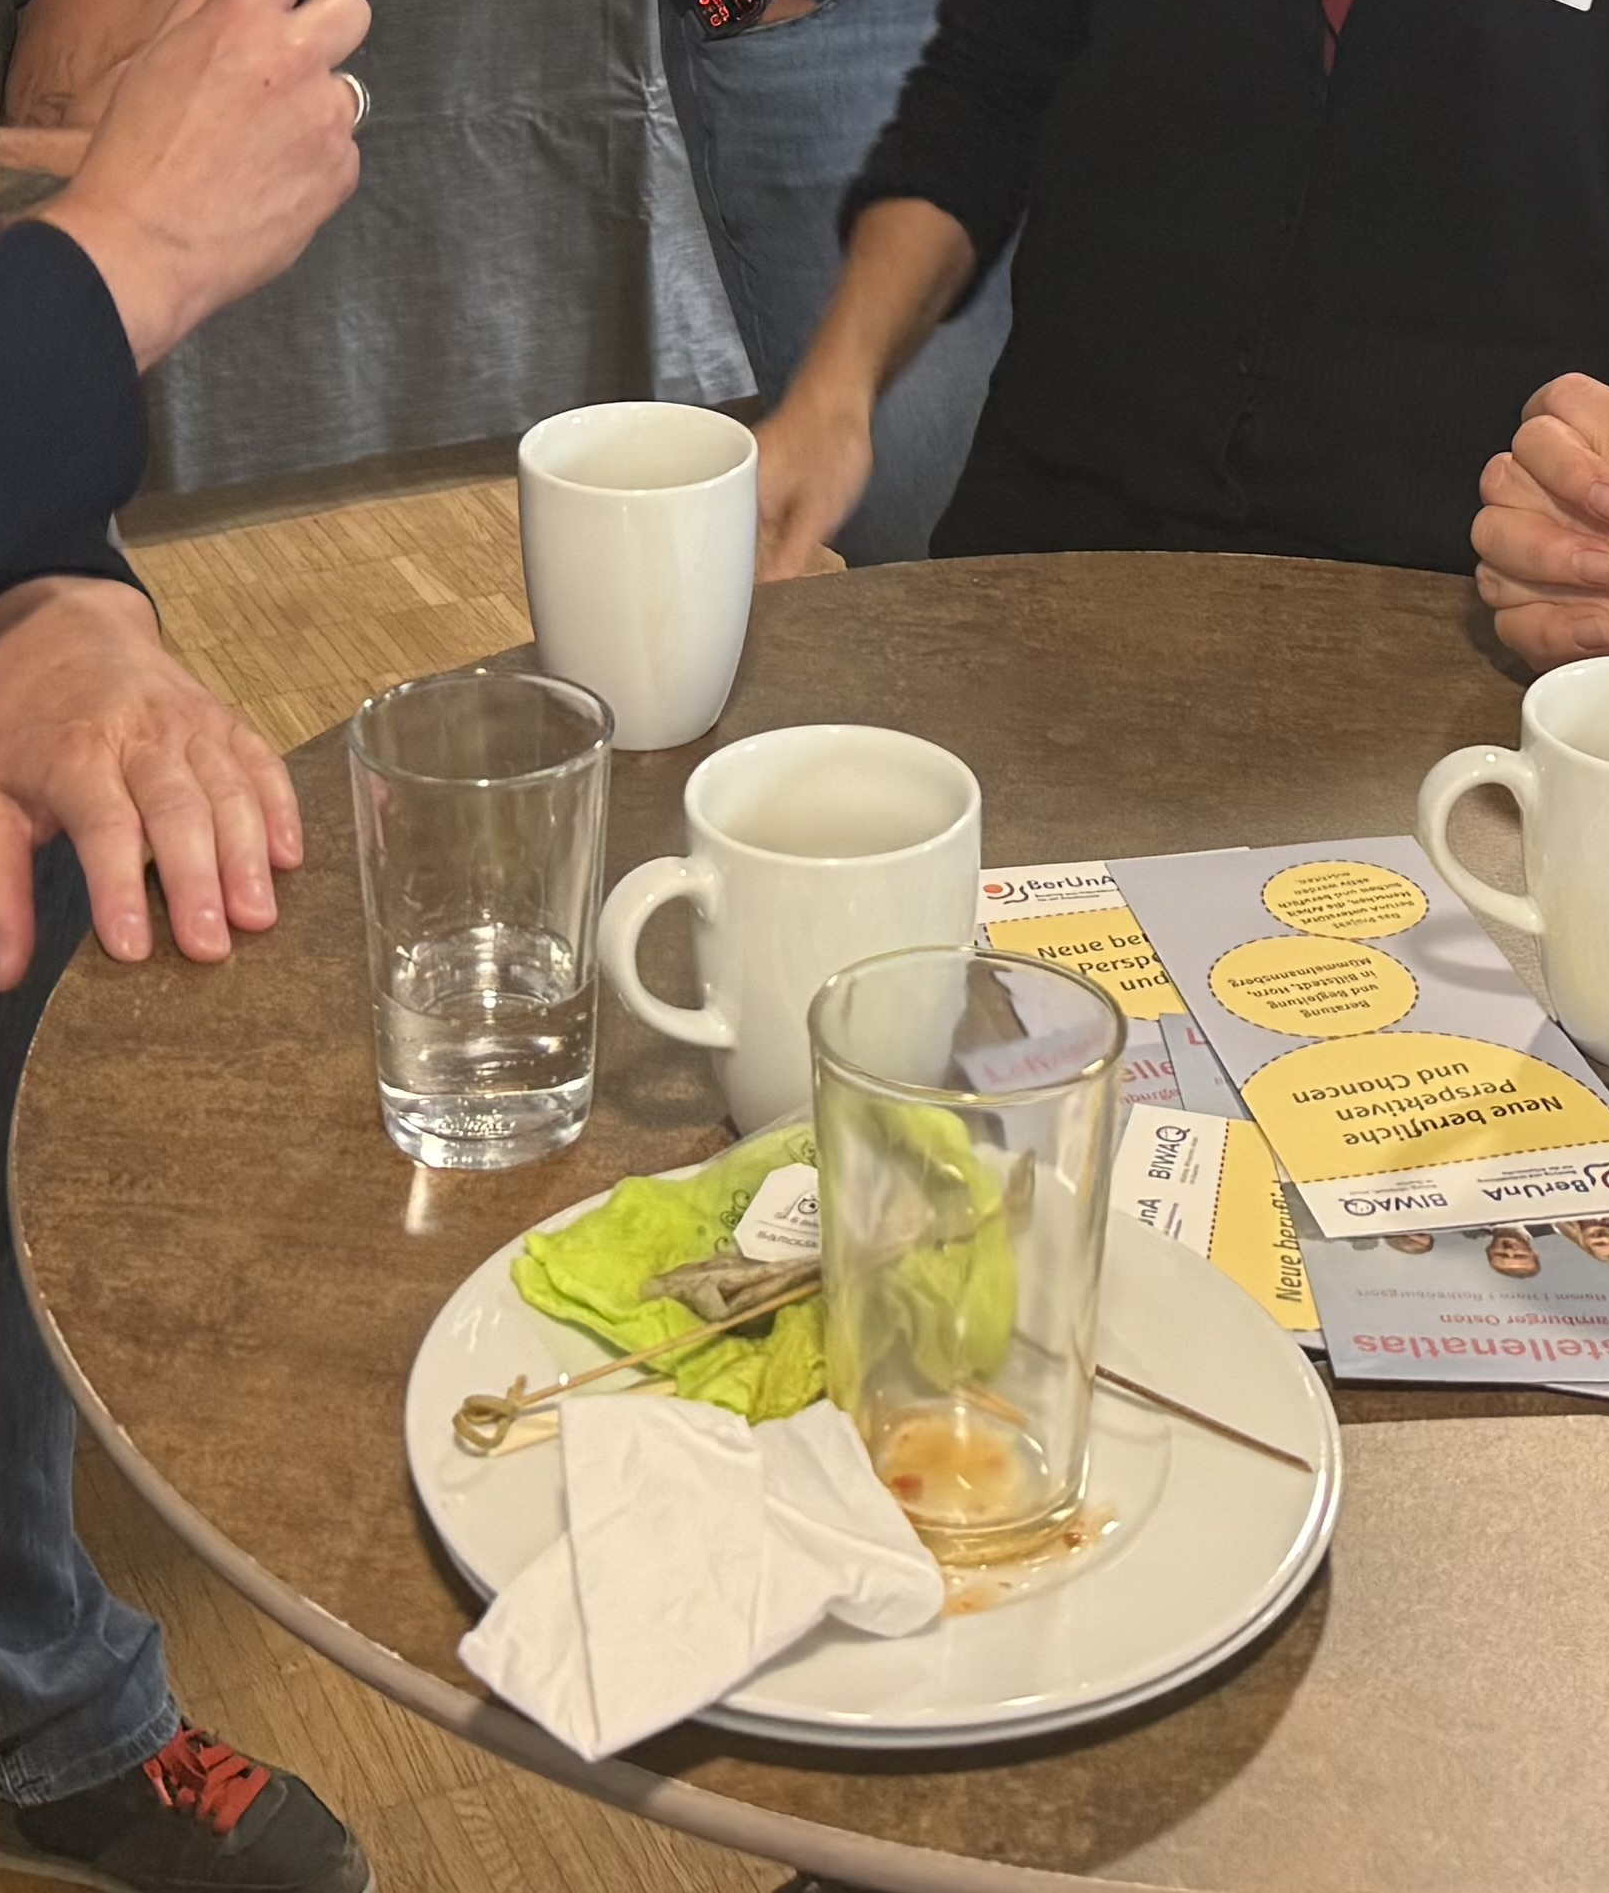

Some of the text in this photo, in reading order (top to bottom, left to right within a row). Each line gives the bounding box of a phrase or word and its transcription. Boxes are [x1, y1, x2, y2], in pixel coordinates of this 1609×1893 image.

[1037, 940, 1105, 960] Neue
[1119, 970, 1170, 992] und
[1227, 957, 1373, 988] Mümmelmannsberg
[1359, 970, 1378, 980] in
[1266, 984, 1380, 1010] und Begleitung
[1299, 999, 1371, 1019] Beratung
[1292, 1061, 1470, 1105] und Chancen
[1335, 1079, 1518, 1122] Perspektiven
[1342, 1095, 1563, 1146] Neue berufliche
[1147, 1124, 1191, 1181] BIWAQ
[1481, 1178, 1590, 1202] BerUnA
[1339, 1192, 1449, 1217] BIWAQ
[1275, 1251, 1303, 1303] Neue
[1439, 1312, 1500, 1326] Osten
